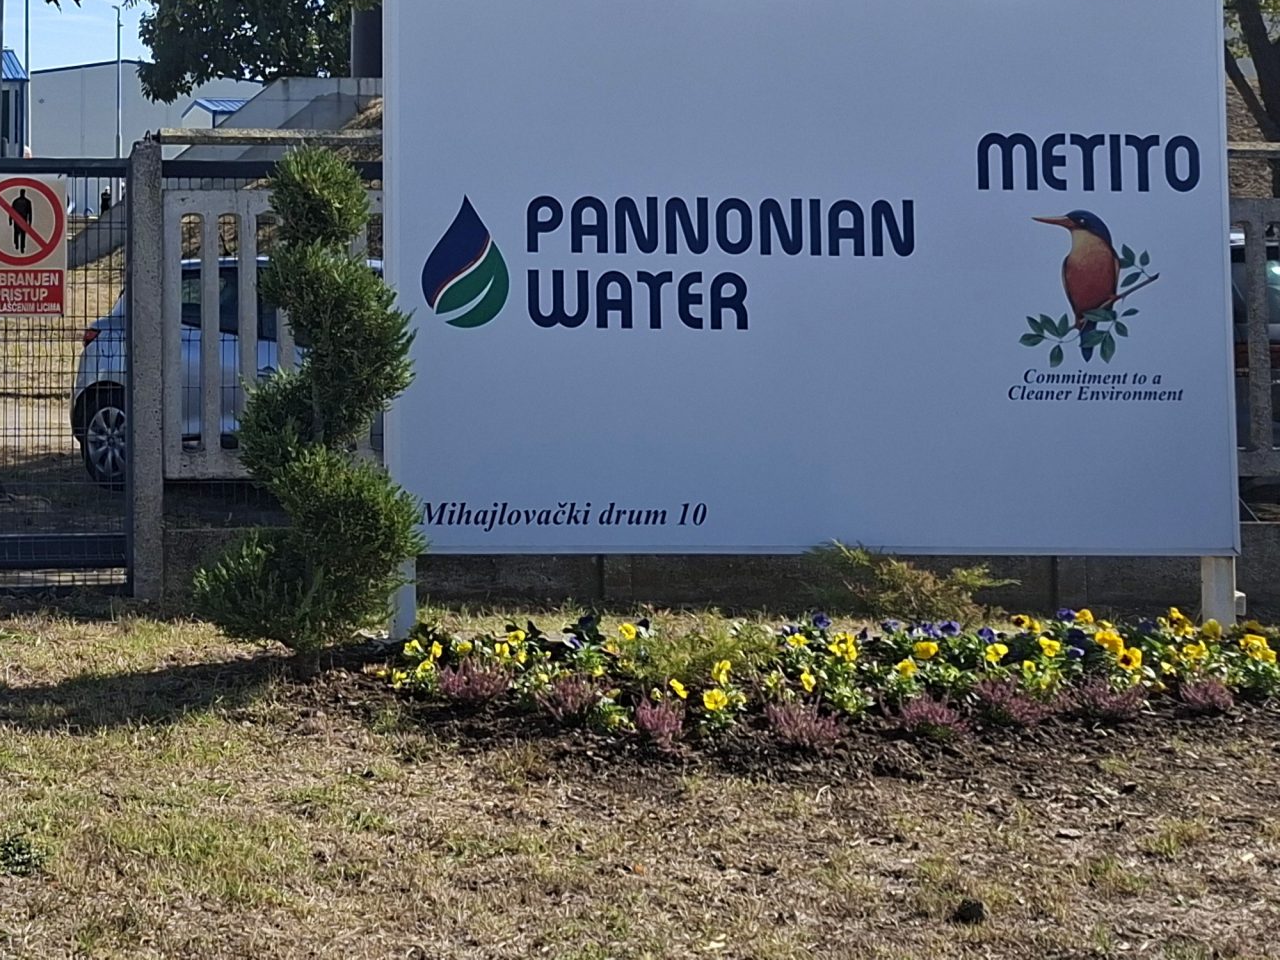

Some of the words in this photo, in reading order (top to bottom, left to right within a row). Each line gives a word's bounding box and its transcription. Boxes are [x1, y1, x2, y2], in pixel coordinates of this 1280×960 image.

[977, 132, 1201, 193] METITO
[526, 195, 915, 257] PANNONIAN
[36, 302, 61, 313] LICIMA
[527, 269, 749, 331] WATER
[1023, 369, 1128, 385] Commitment
[1132, 372, 1148, 385] to
[1152, 374, 1162, 385] a
[1007, 385, 1073, 401] Cleaner
[1076, 386, 1184, 402] Environment
[419, 502, 591, 533] Mihajlovački
[598, 502, 667, 526] drum
[677, 502, 708, 526] 10
